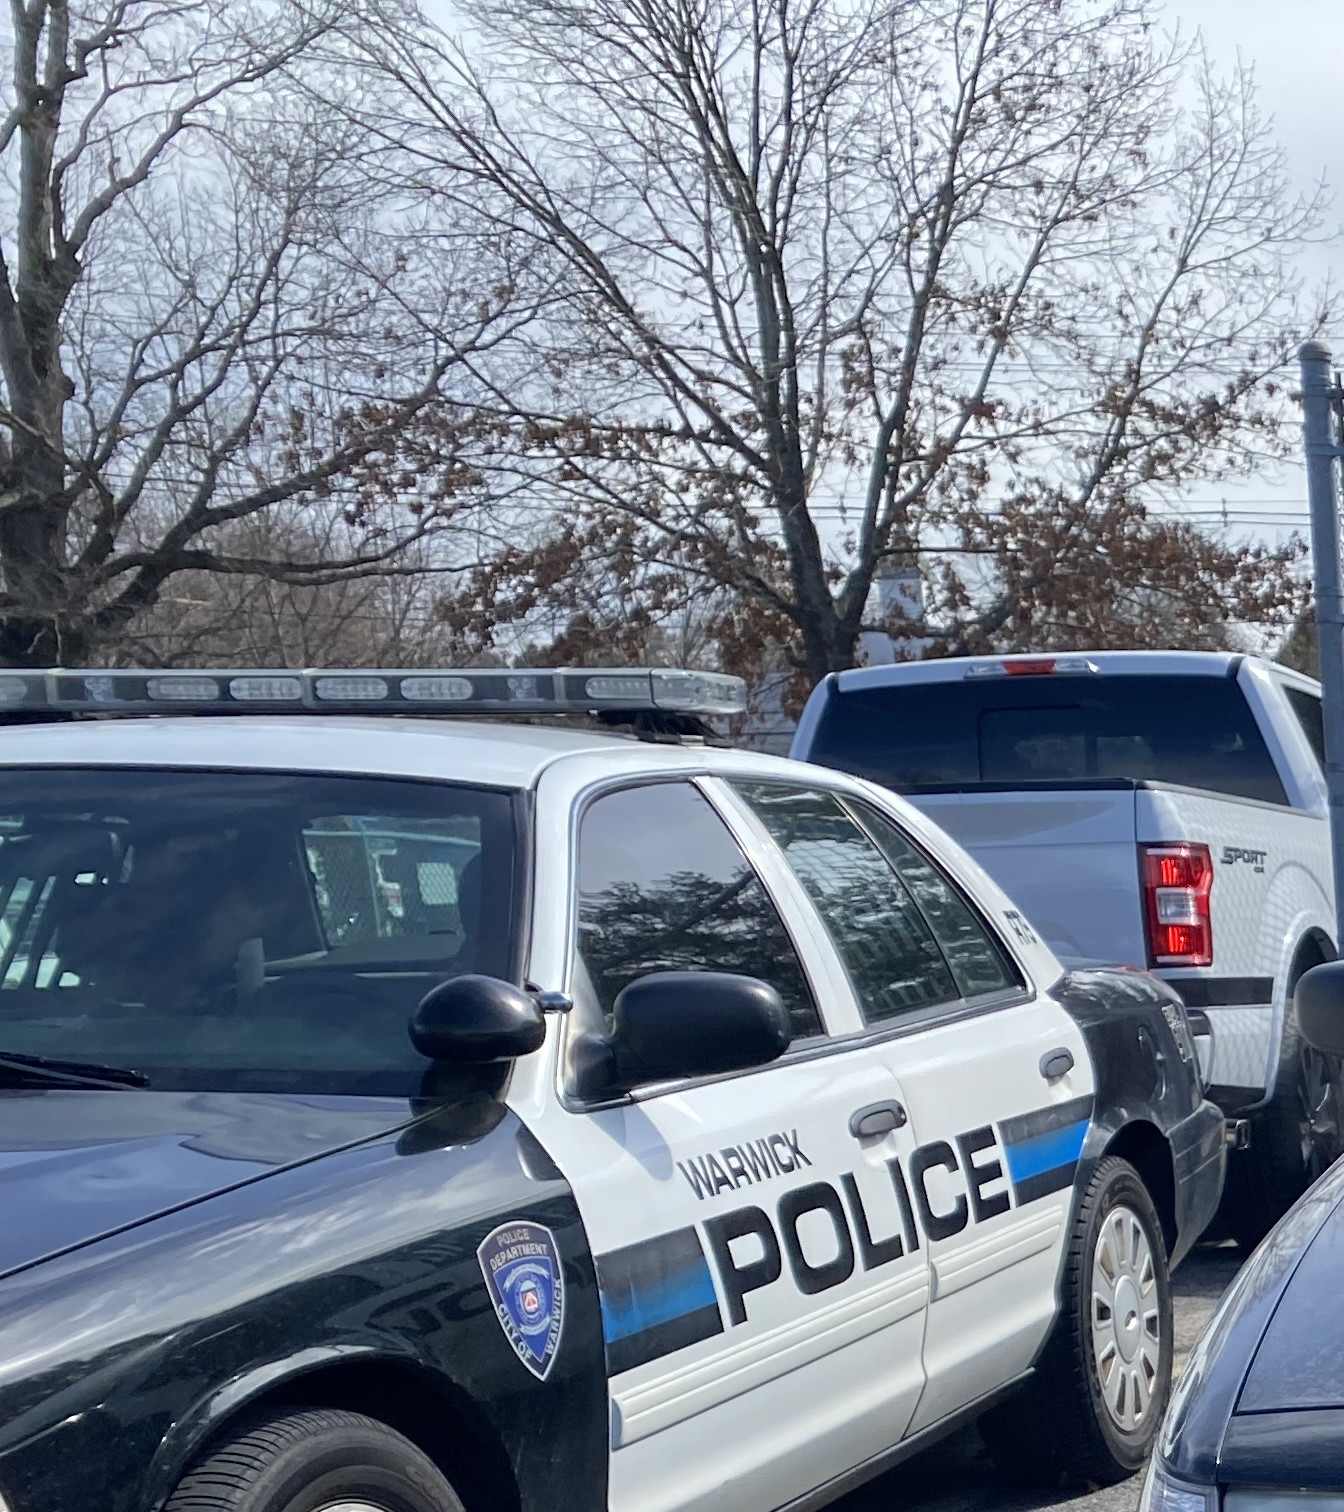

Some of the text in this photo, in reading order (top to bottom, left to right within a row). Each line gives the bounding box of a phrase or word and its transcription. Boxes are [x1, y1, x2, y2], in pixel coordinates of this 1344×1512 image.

[1220, 846, 1267, 865] SPORT
[678, 1128, 813, 1202] WARWICK
[496, 1228, 530, 1248] POLICE
[702, 1122, 1011, 1326] POLICE
[489, 1243, 547, 1272] DEPARTMENT
[497, 1303, 519, 1342] CITY
[517, 1342, 532, 1361] OF
[545, 1278, 562, 1355] WARWICK
